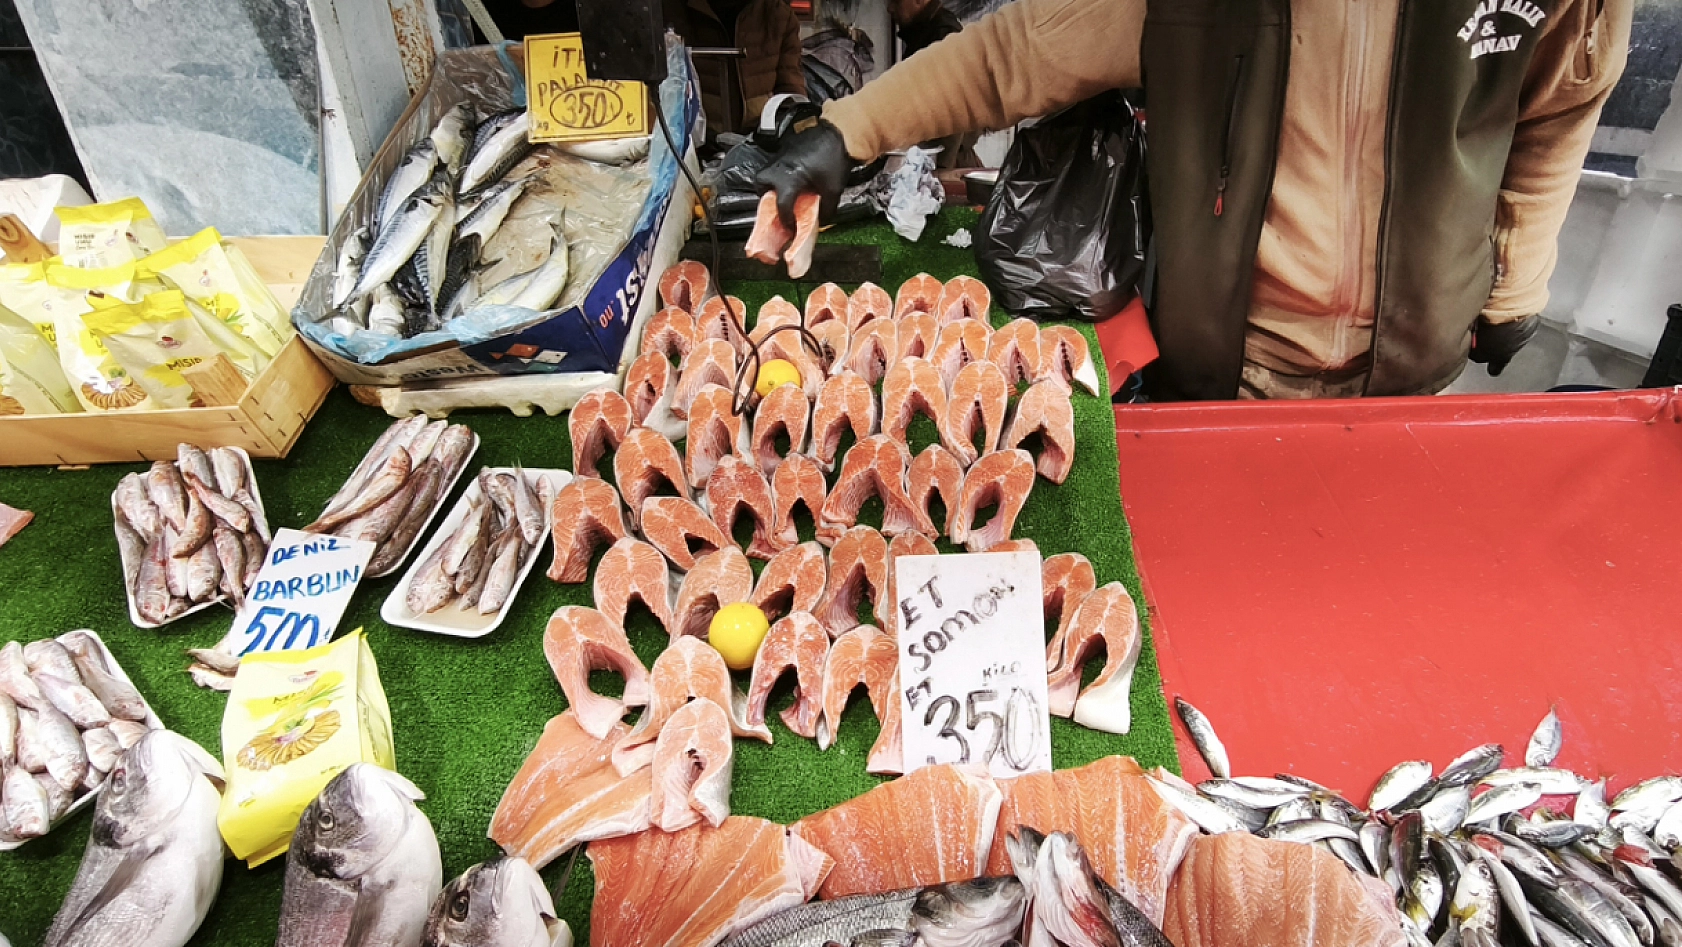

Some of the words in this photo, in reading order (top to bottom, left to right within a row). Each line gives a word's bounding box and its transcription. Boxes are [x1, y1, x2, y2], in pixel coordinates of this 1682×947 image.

[1481, 20, 1496, 37] &
[561, 91, 608, 128] 350
[252, 565, 360, 602] BARBUN
[900, 574, 943, 631] ET
[905, 676, 932, 711] ET
[923, 685, 1043, 771] 350
